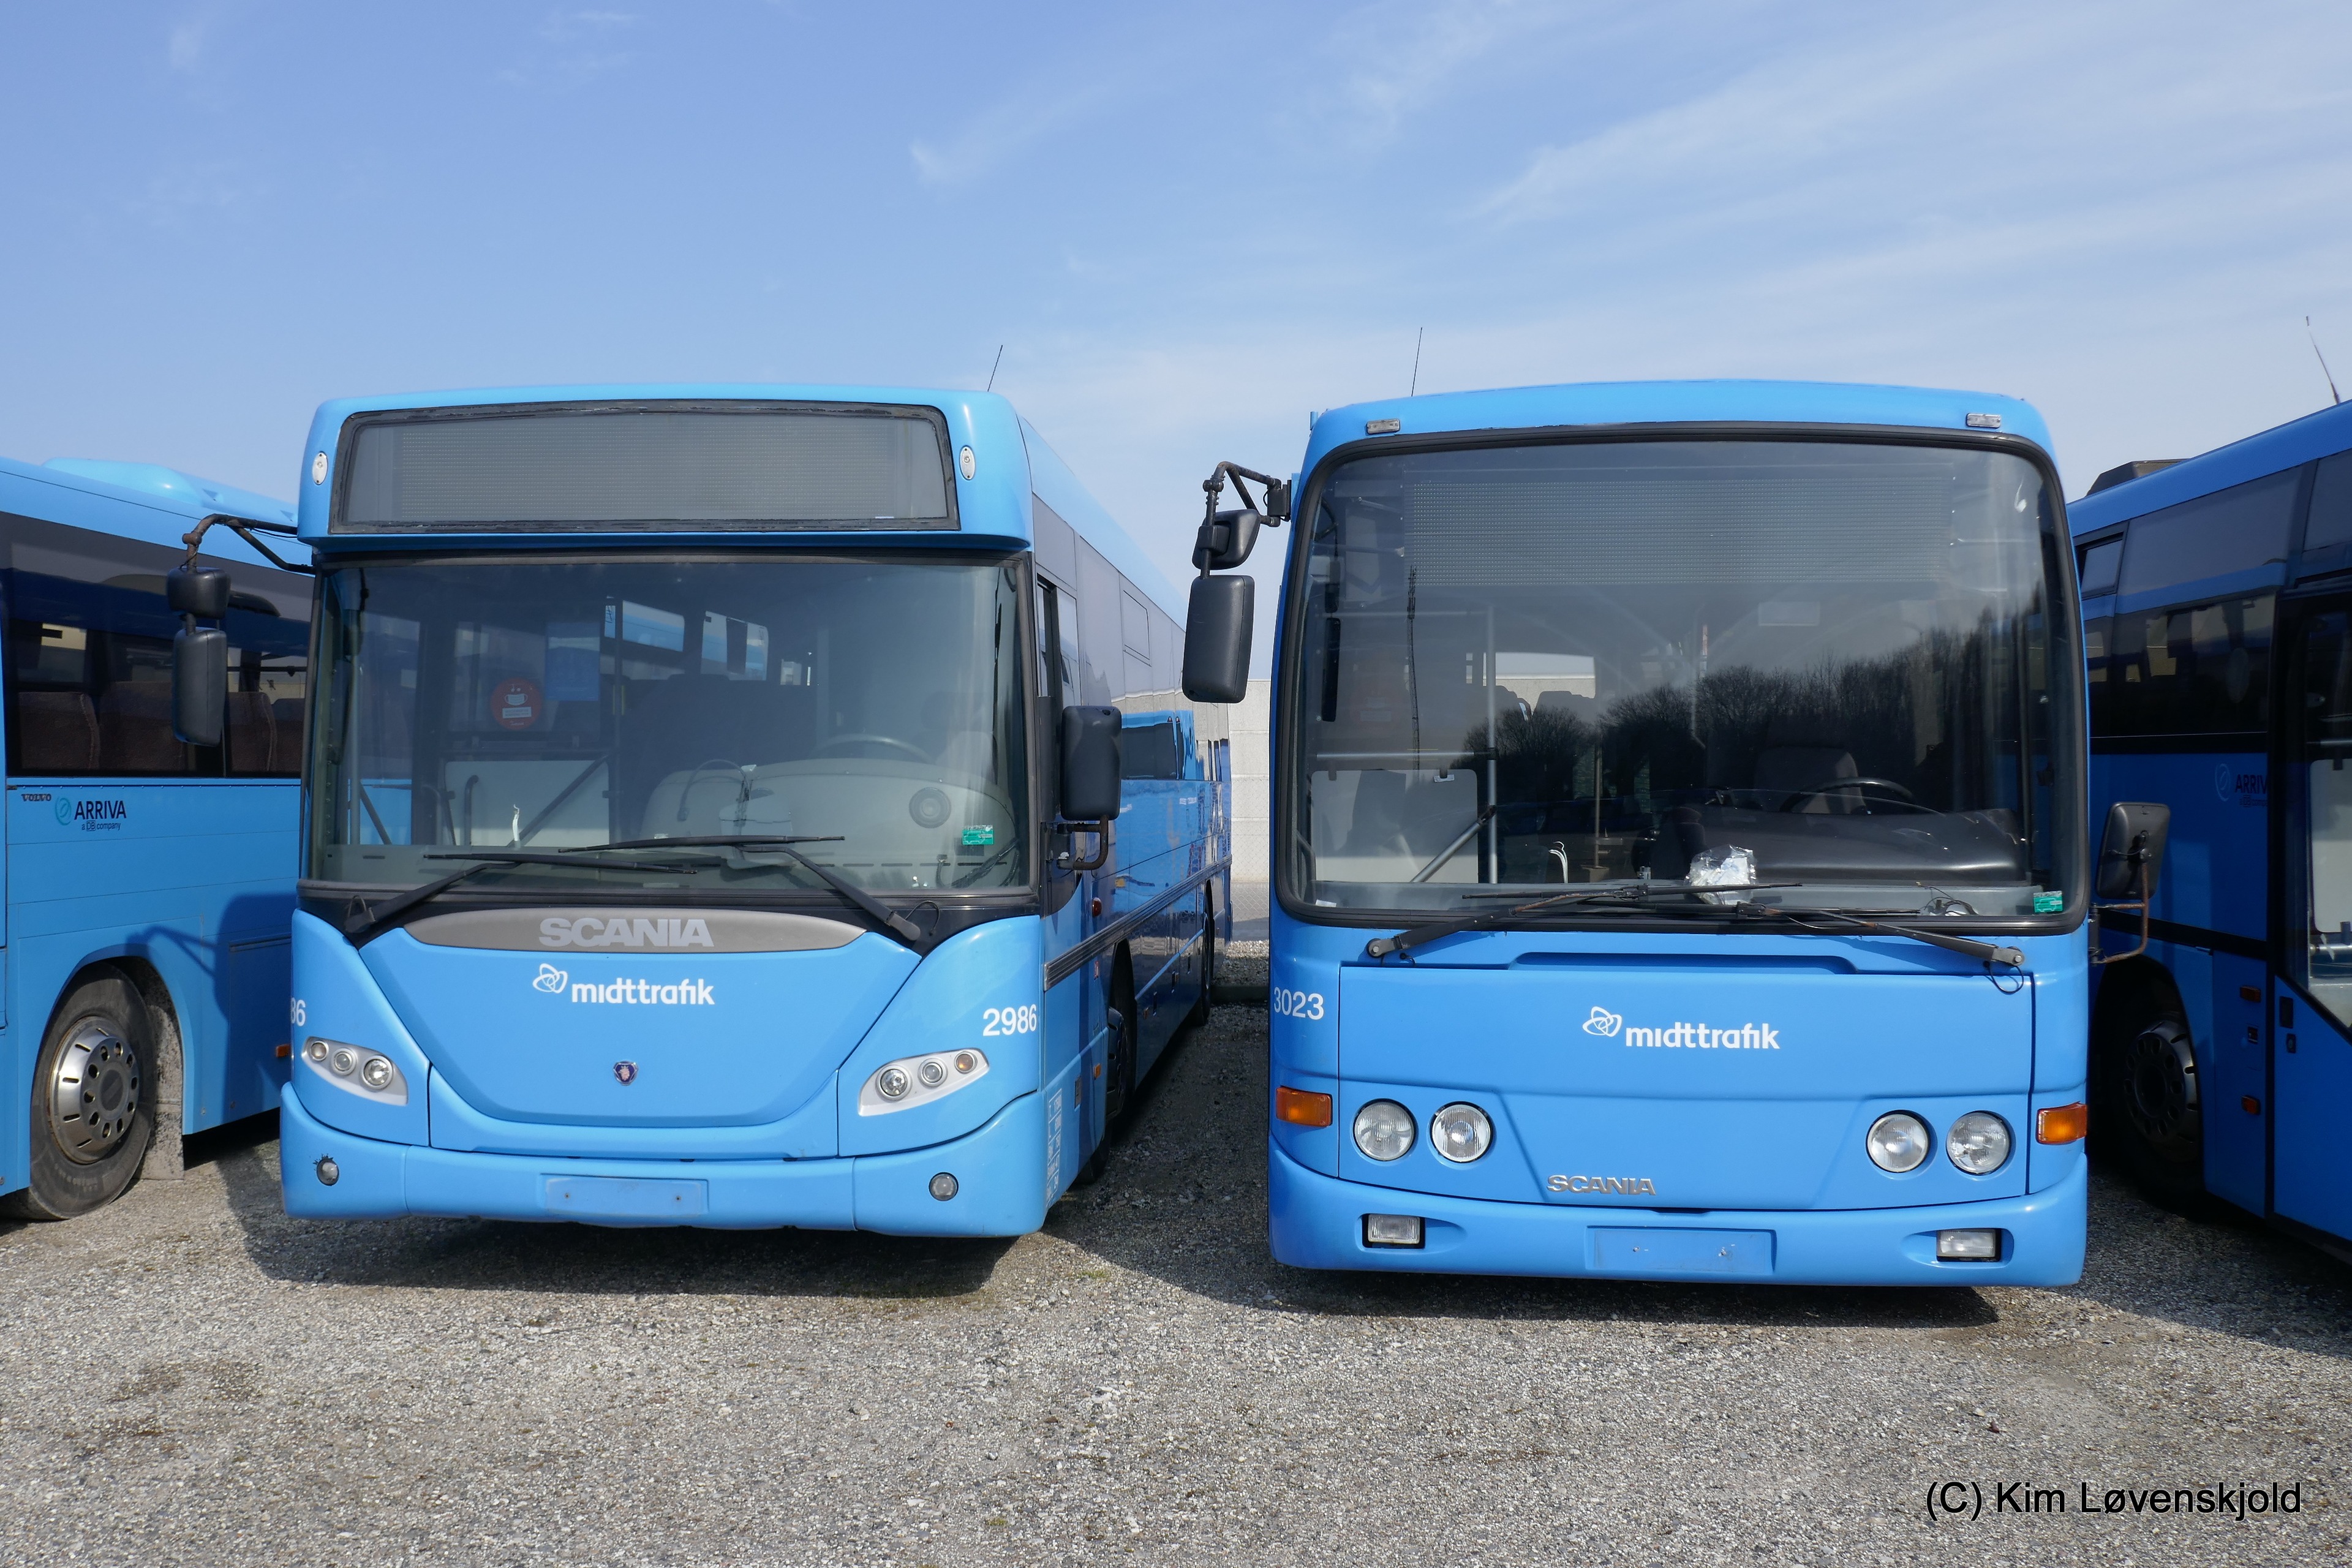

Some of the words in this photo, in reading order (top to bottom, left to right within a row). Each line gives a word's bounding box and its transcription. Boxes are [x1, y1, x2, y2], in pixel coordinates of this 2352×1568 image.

[21, 793, 52, 802] VOLVO
[74, 800, 127, 820] ARRIVA
[86, 820, 96, 831] DB
[96, 821, 121, 831] company
[538, 917, 715, 947] SCANIA
[571, 978, 715, 1005] midttrafik
[1274, 987, 1324, 1020] 3023
[982, 1004, 1037, 1036] 2986
[1626, 1022, 1780, 1049] midttrafik
[1547, 1175, 1656, 1196] SCANIA
